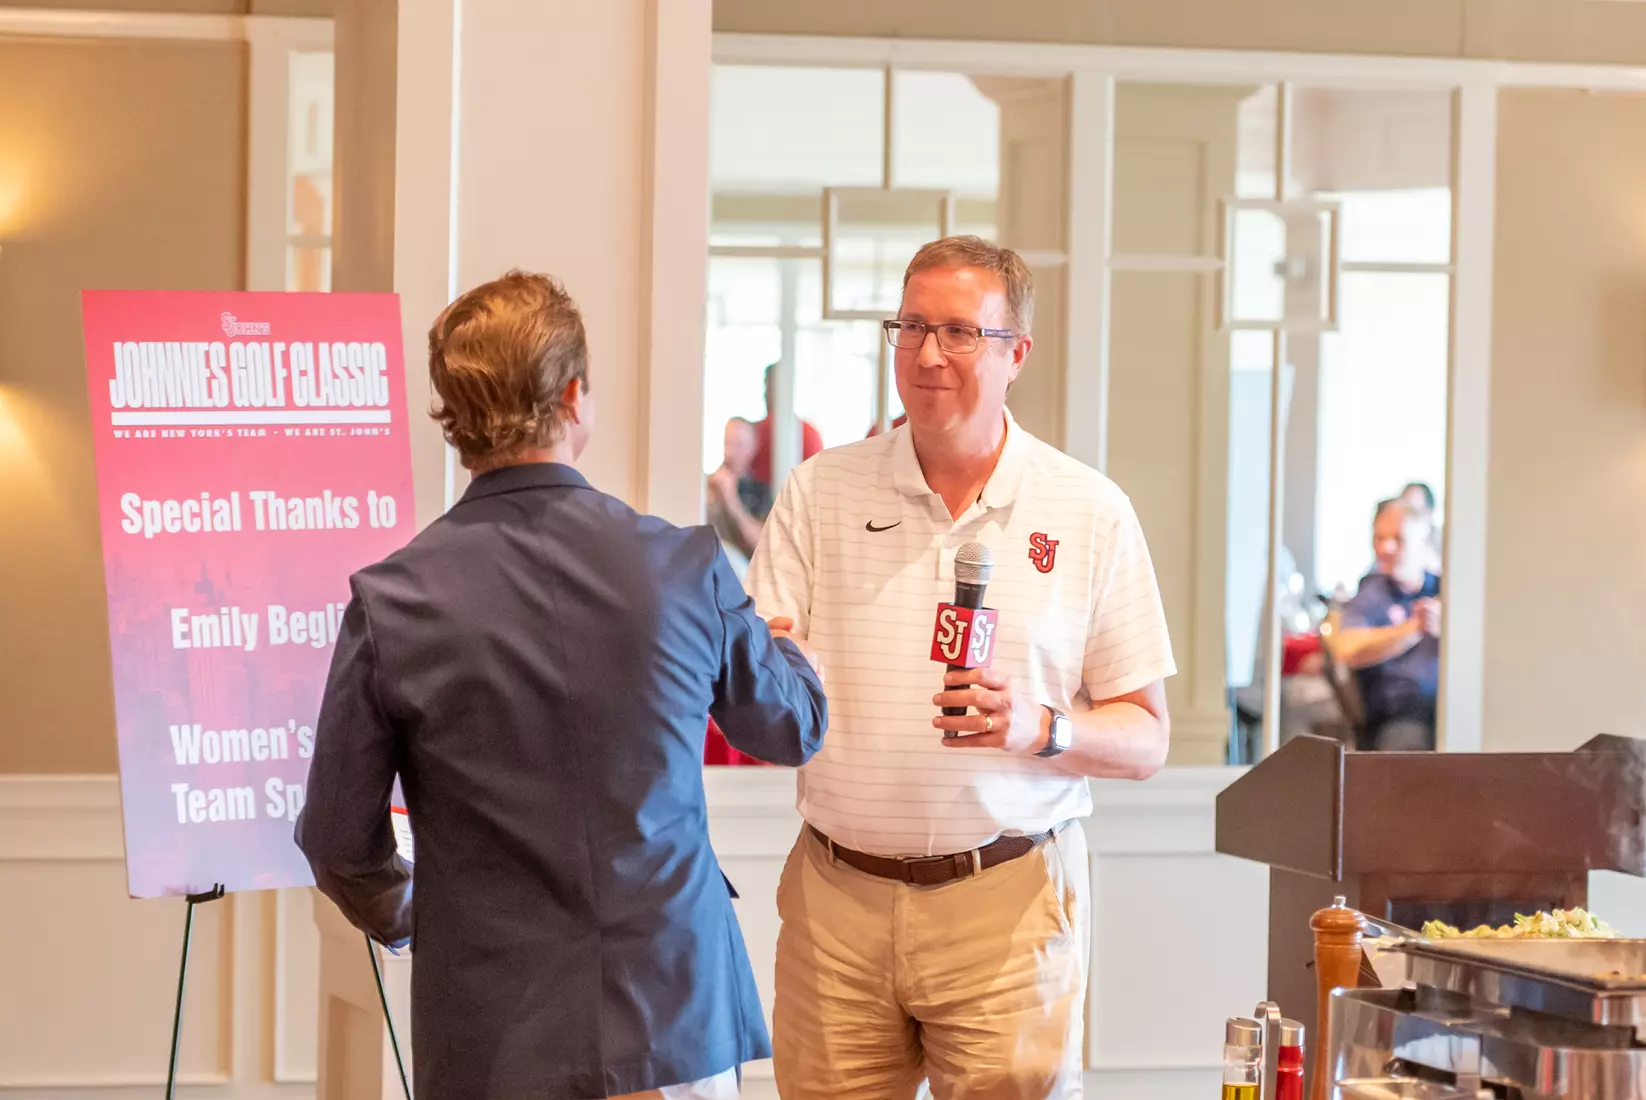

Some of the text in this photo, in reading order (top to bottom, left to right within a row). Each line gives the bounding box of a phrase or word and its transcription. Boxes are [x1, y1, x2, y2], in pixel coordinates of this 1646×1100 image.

[109, 342, 389, 407] JOHNNIES GOLF CLASSIC
[113, 427, 391, 438] WE ARE NEW YORK'S TEAM WE ARE ST. JOHN'S
[120, 490, 397, 538] Special Thanks to
[170, 606, 258, 651] Emily
[169, 719, 314, 765] Women's
[171, 783, 255, 824] Team
